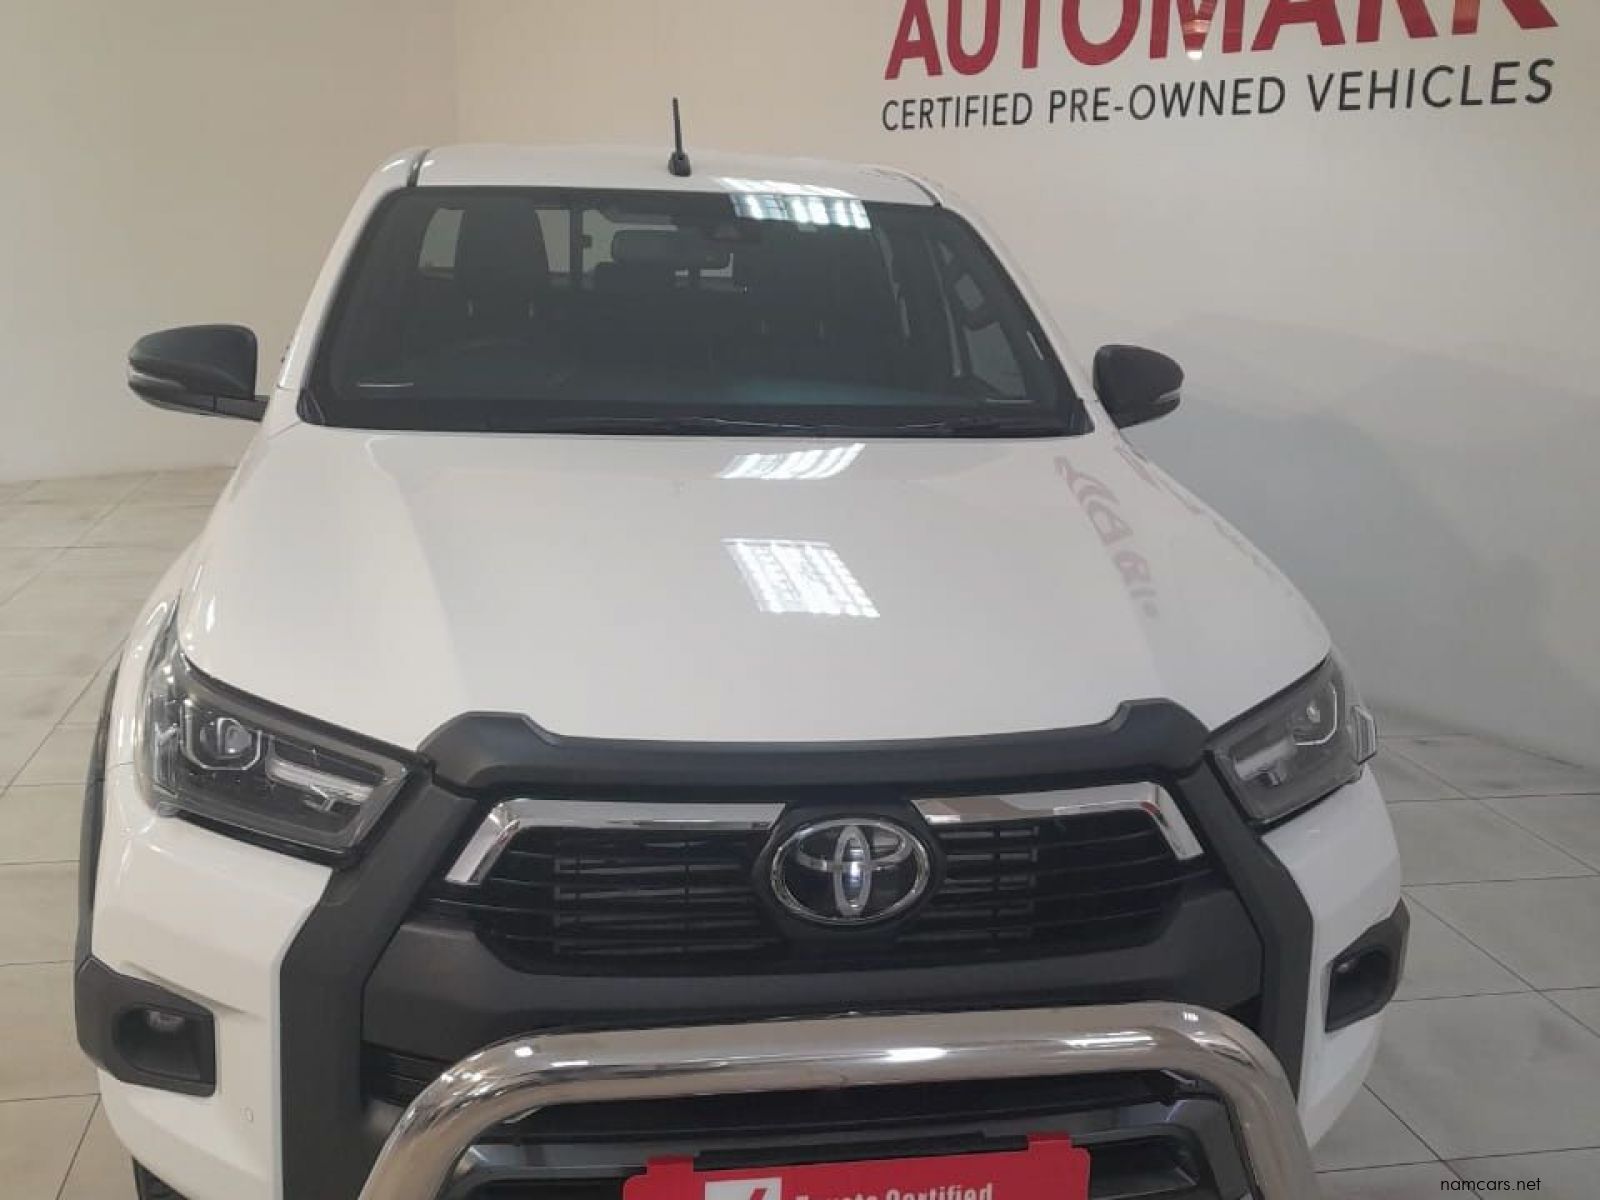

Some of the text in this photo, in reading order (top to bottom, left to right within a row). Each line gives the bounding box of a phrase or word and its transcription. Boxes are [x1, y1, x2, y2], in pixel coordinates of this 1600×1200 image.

[882, 59, 1555, 131] CERTIFIED PRE-OWNED VEHICLES
